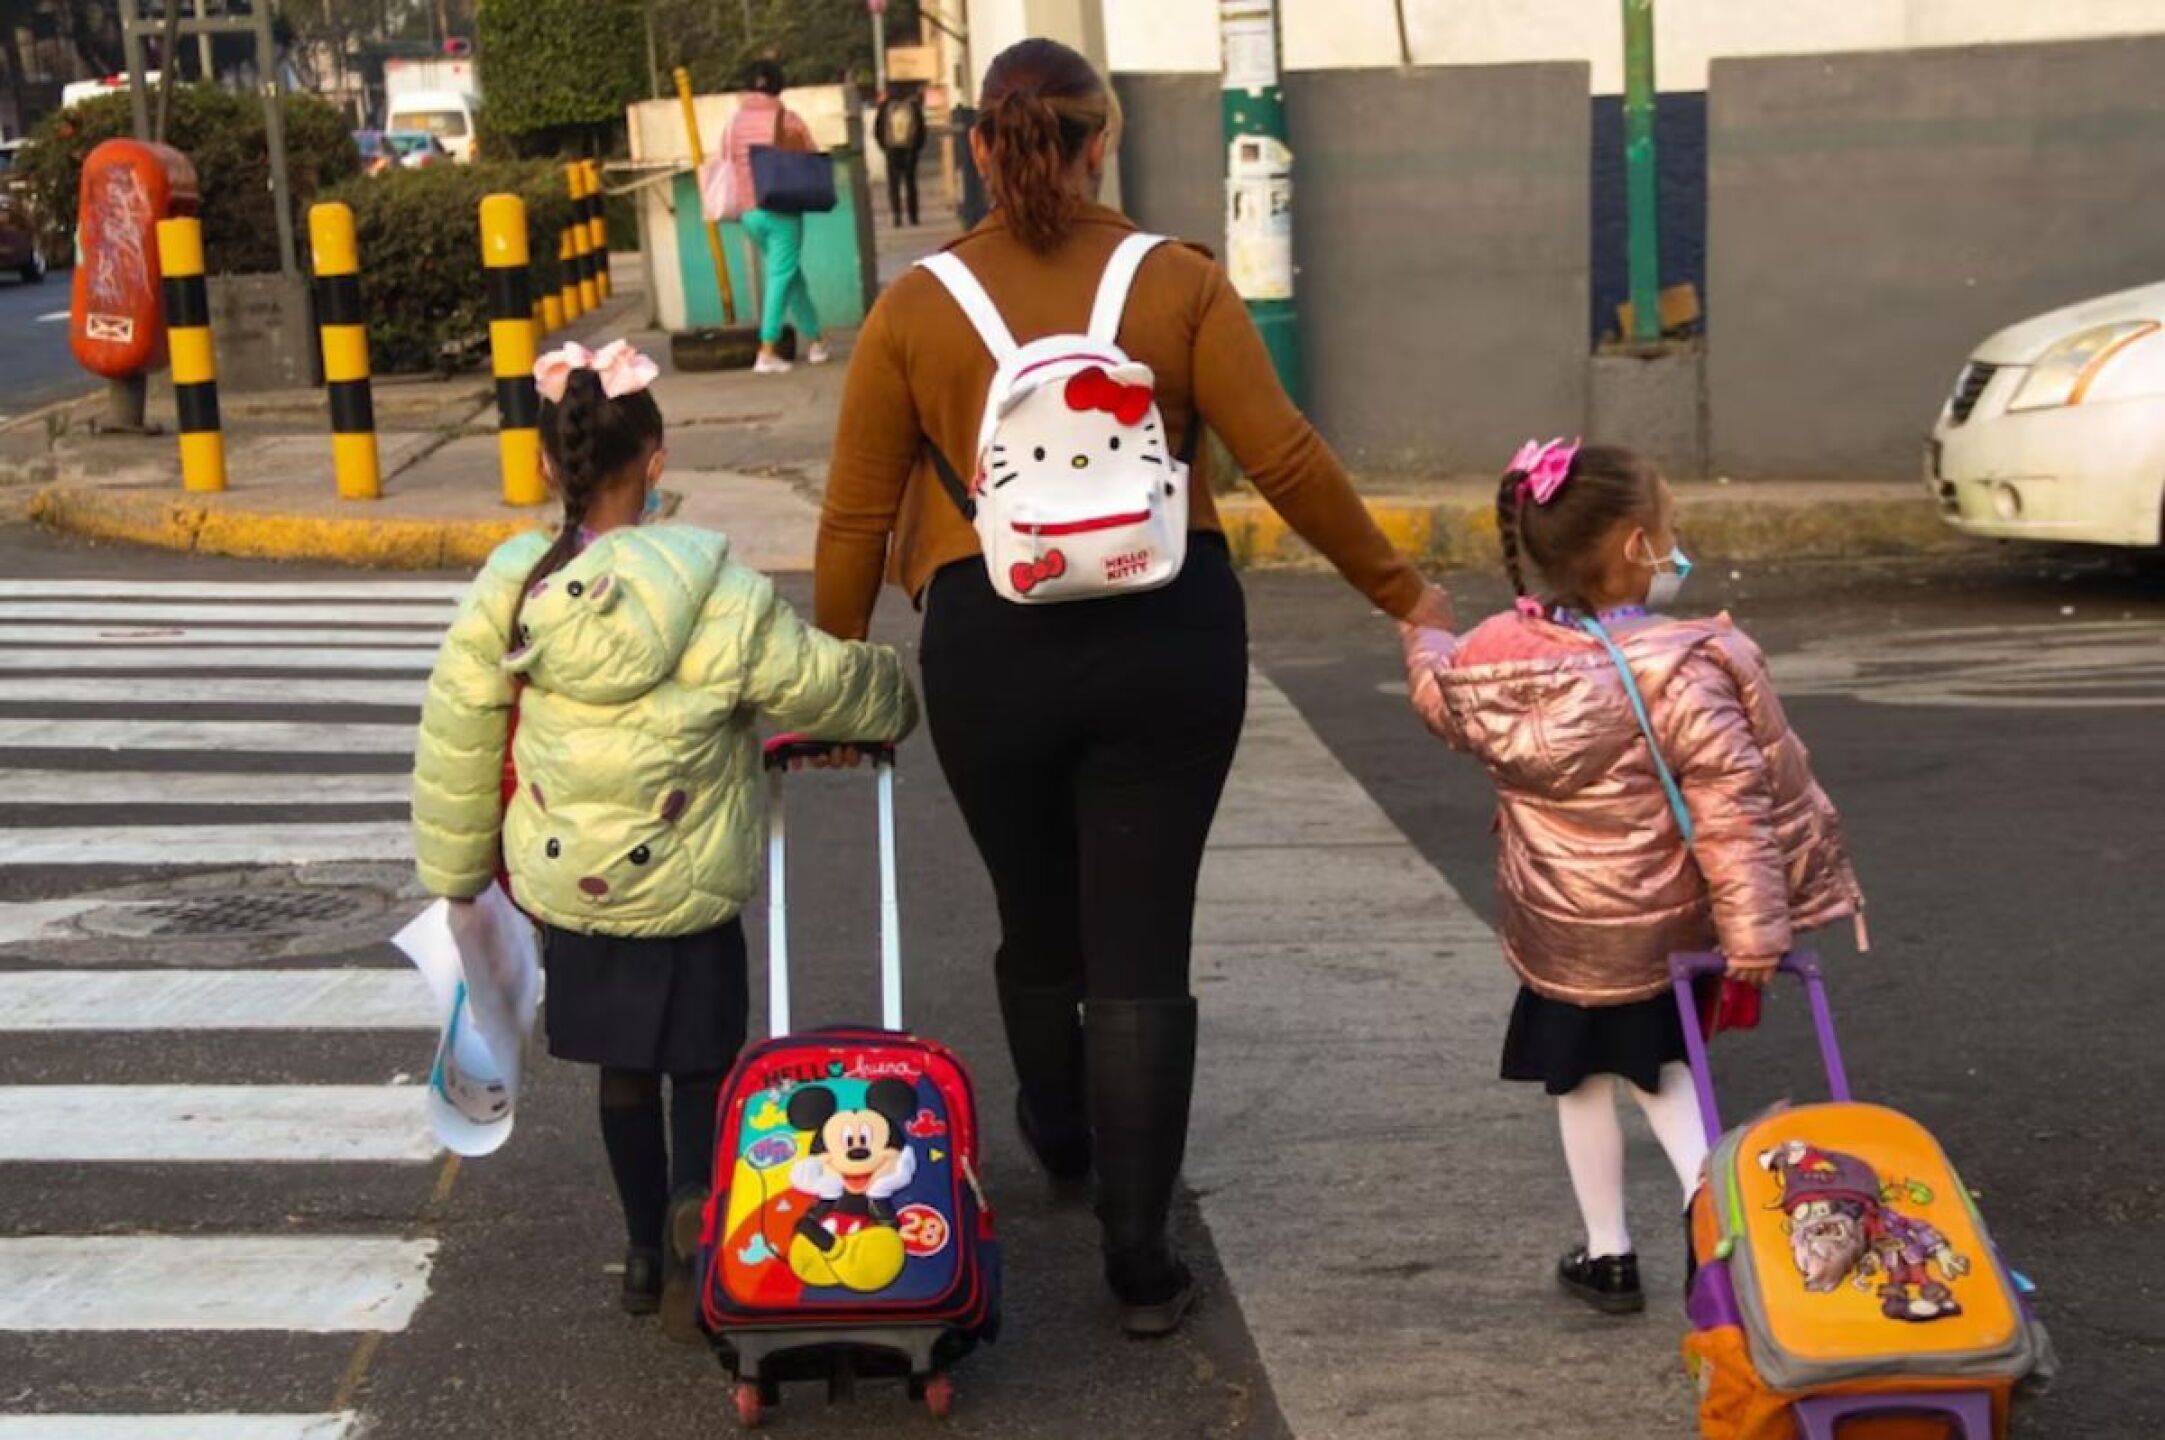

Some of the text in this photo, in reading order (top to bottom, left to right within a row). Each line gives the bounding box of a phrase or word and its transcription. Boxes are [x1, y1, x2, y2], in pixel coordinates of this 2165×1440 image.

[1105, 549, 1148, 569] HELLO
[1107, 562, 1147, 580] KITTY
[899, 1212, 943, 1246] 28
